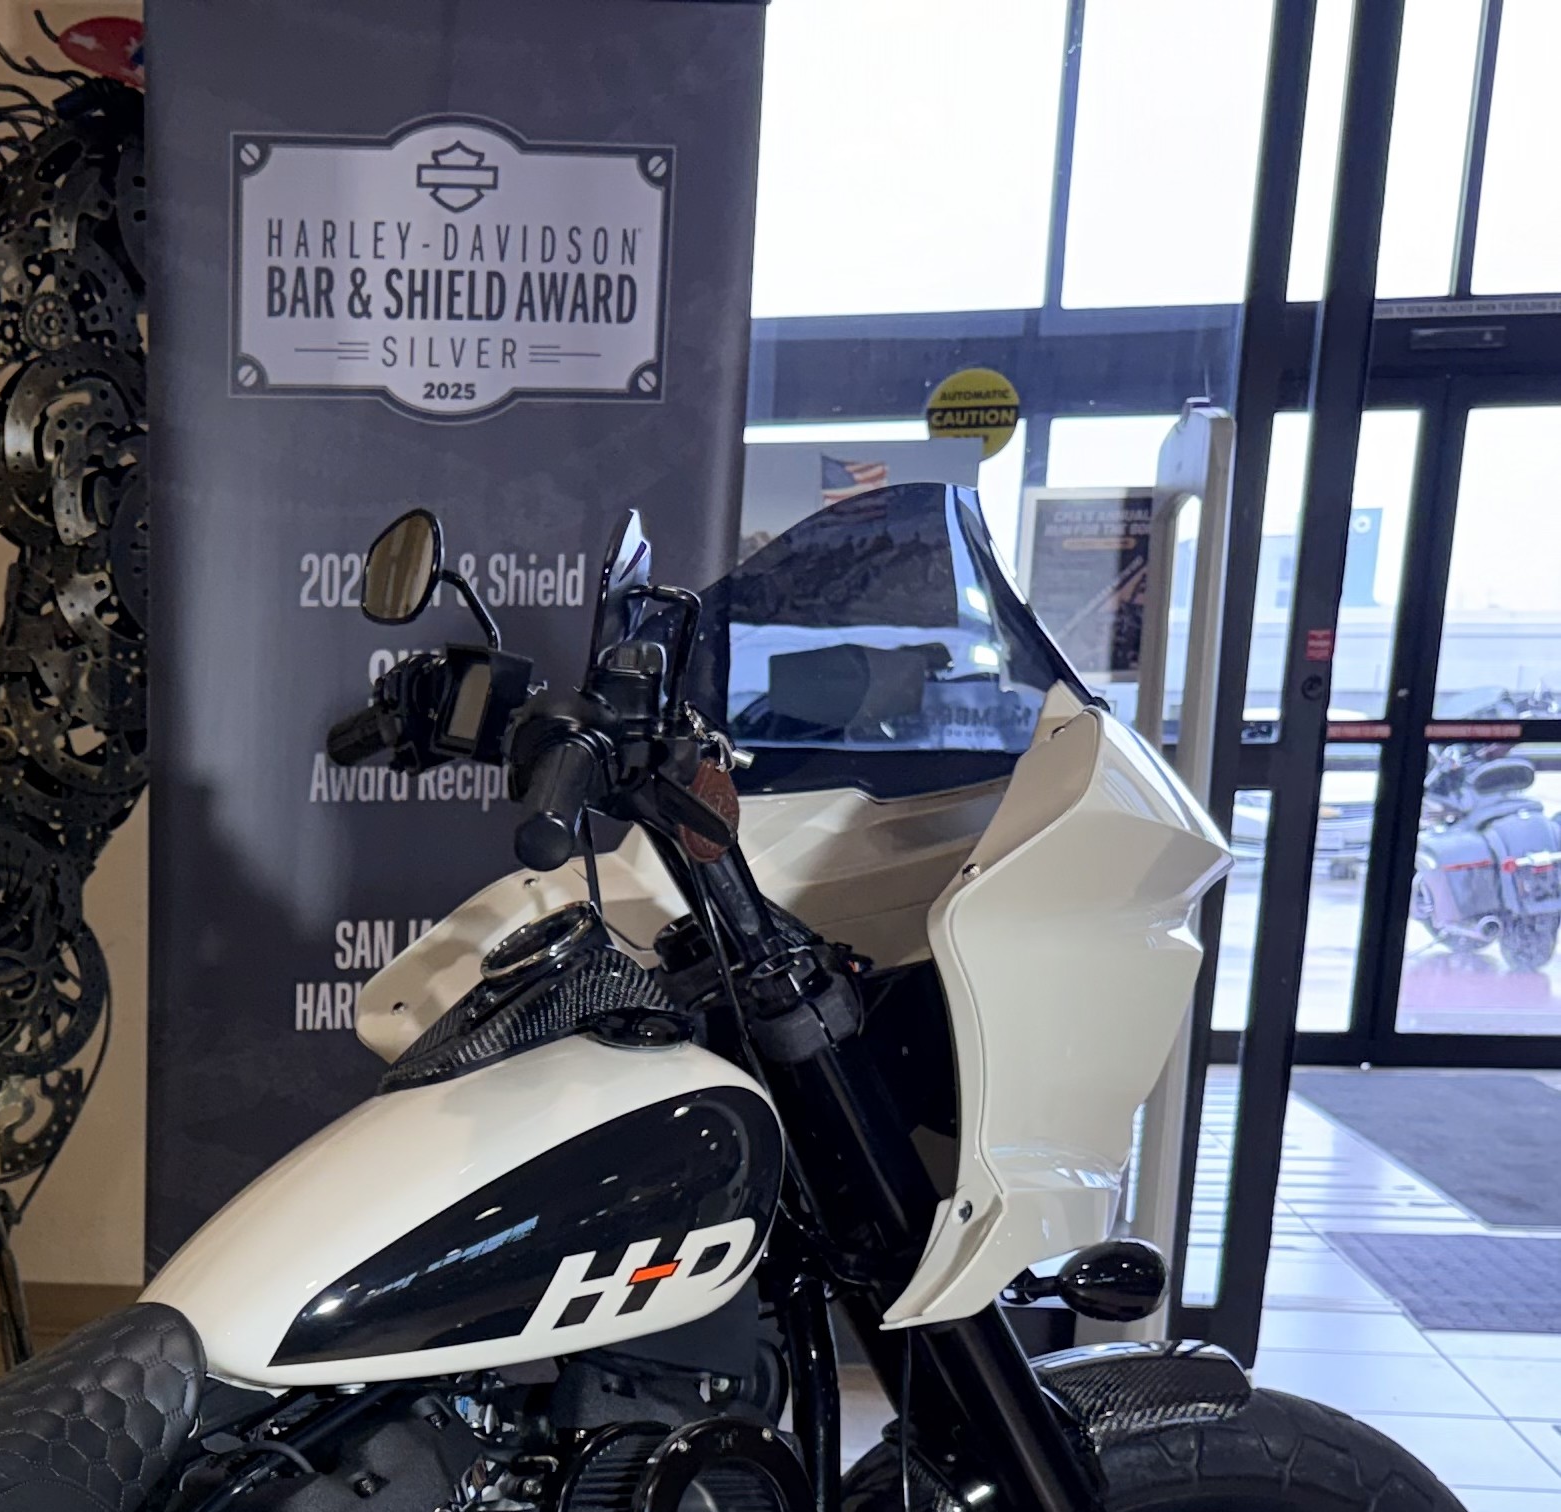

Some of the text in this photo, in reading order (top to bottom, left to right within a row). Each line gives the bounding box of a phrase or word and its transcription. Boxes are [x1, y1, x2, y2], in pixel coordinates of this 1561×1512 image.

[267, 219, 638, 266] HARLEY-DAVIDSON
[267, 266, 638, 324] BAR & SHIELD AWARD
[381, 337, 518, 369] SILVER
[423, 382, 476, 401] 2025
[931, 408, 1016, 427] CAUTION
[299, 553, 367, 607] 202
[488, 553, 586, 607] Shield
[334, 919, 395, 970] SAN
